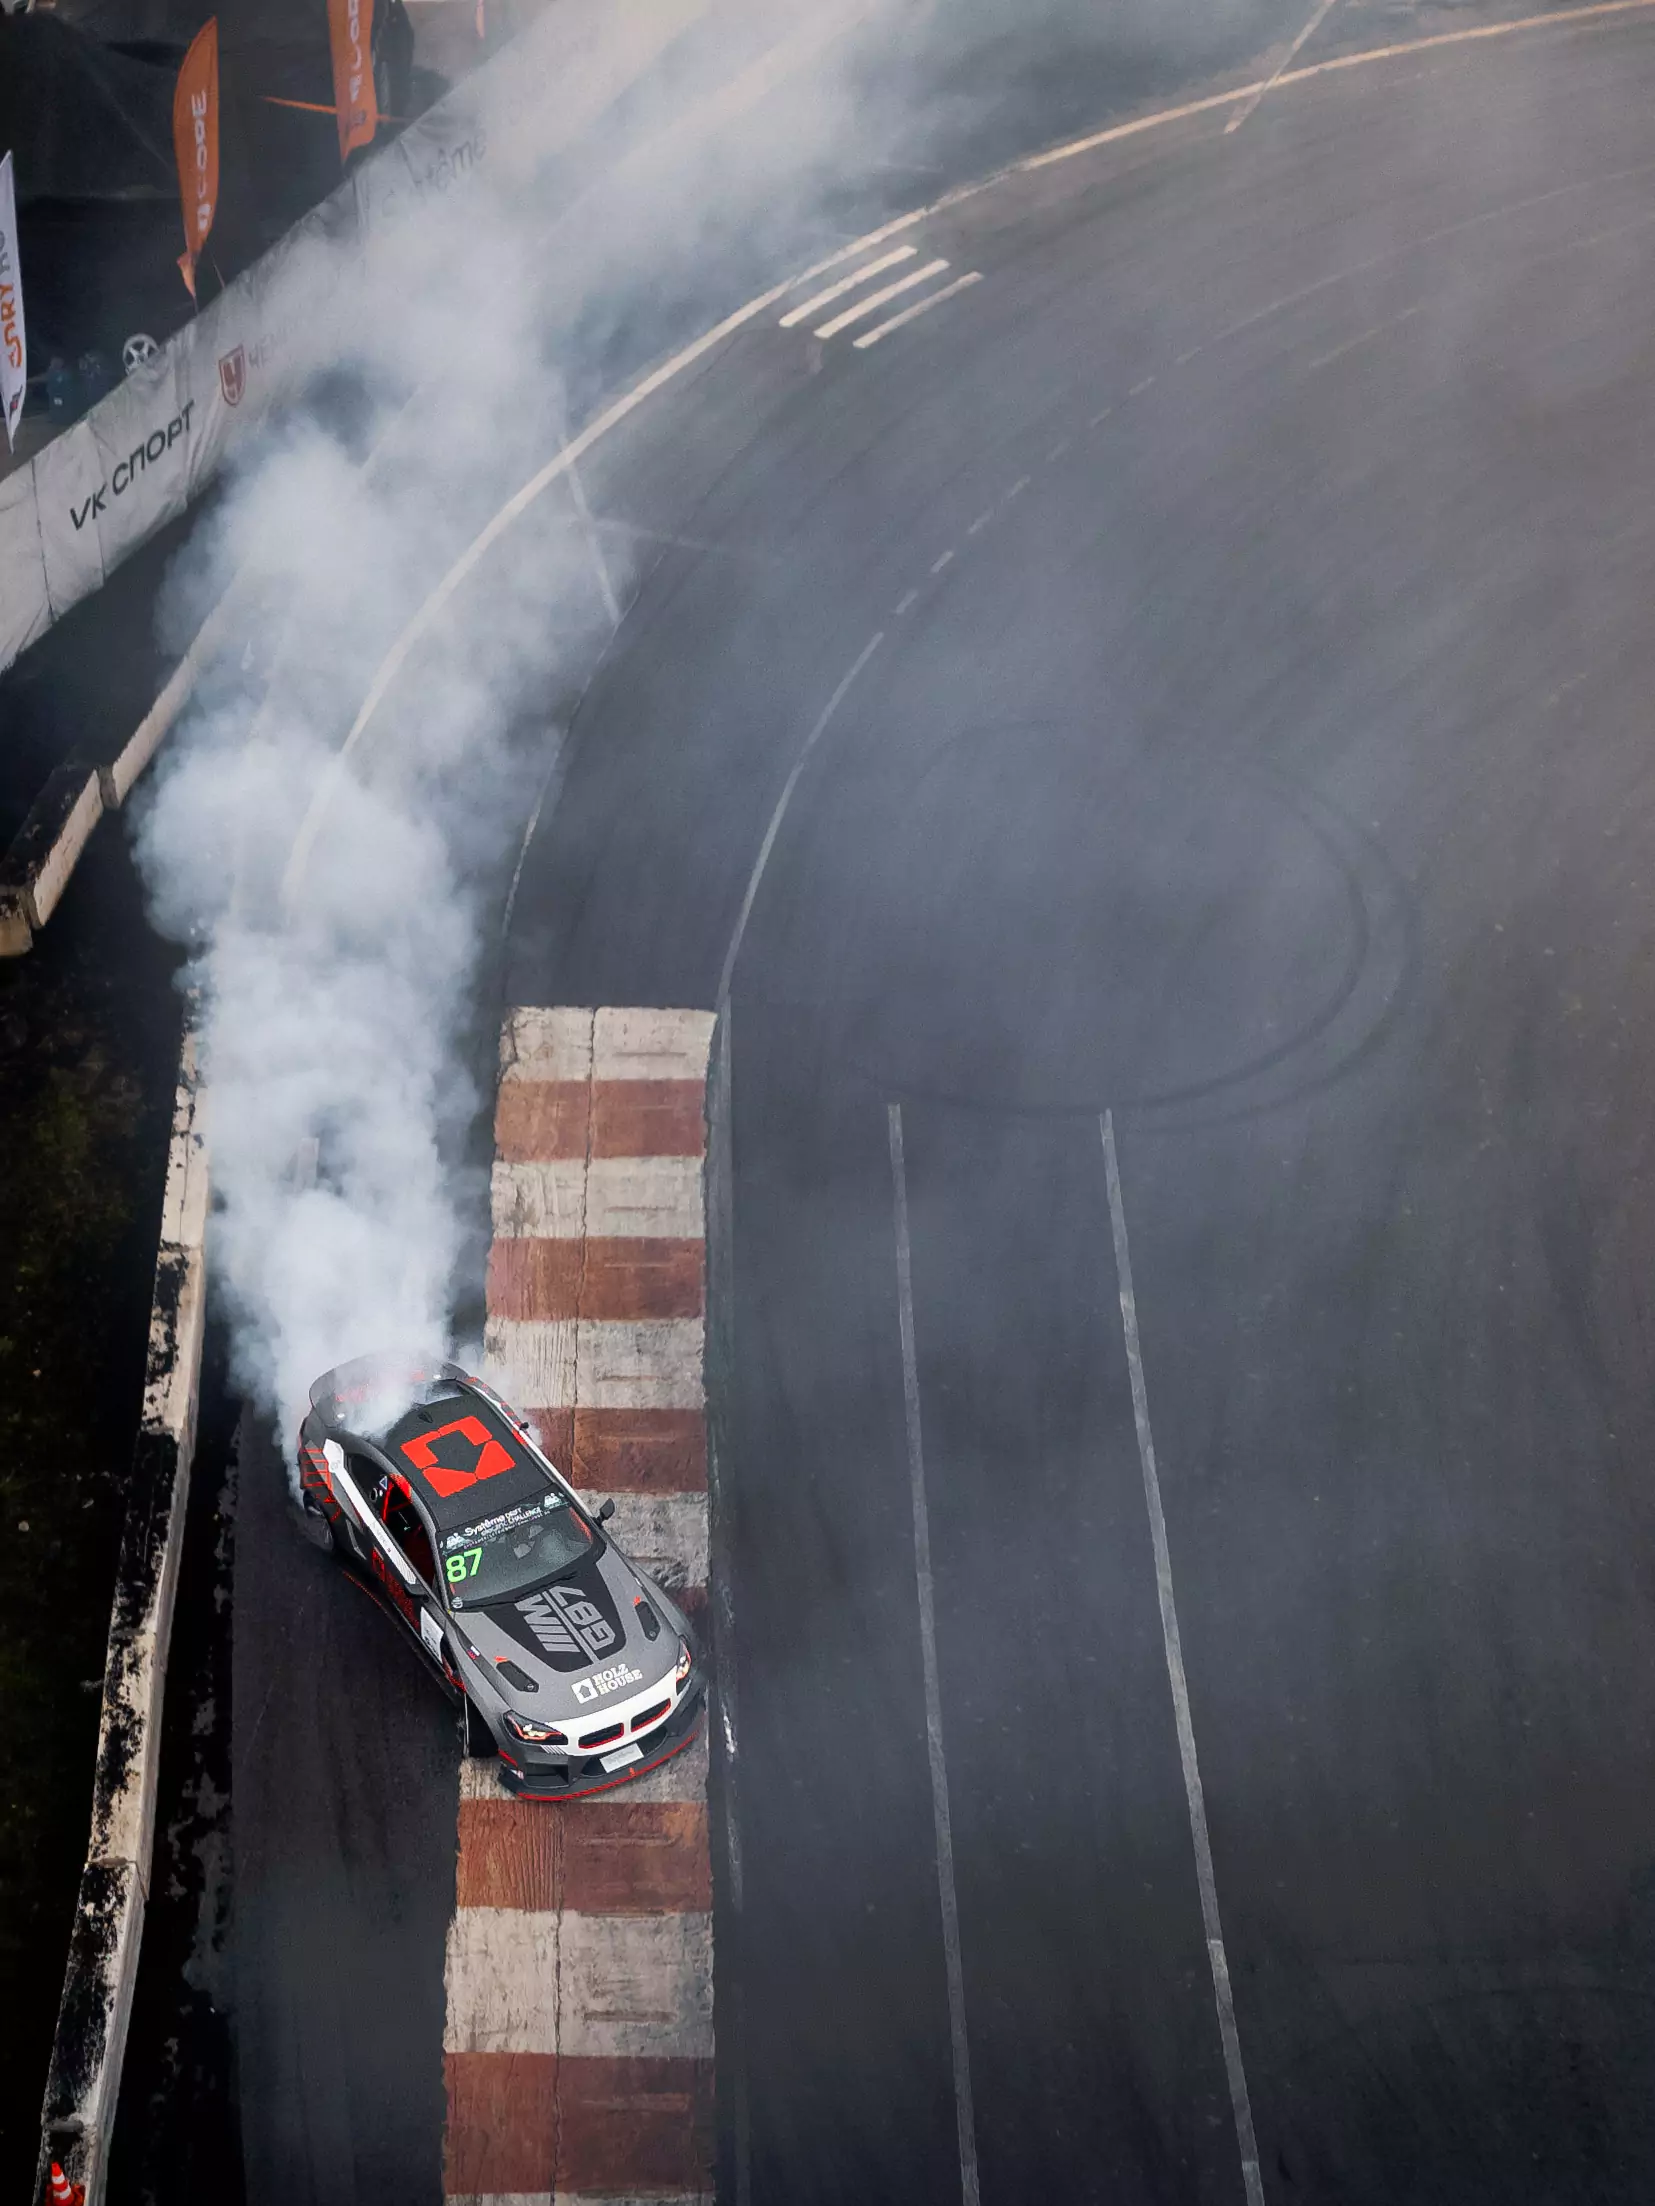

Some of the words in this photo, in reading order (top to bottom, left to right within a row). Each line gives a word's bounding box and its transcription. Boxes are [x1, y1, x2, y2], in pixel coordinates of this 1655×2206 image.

[69, 481, 108, 531] VK
[111, 399, 196, 497] СПОРТ
[445, 1546, 483, 1583] 87
[591, 1663, 630, 1687] HOLZ
[596, 1669, 644, 1696] HOUSE
